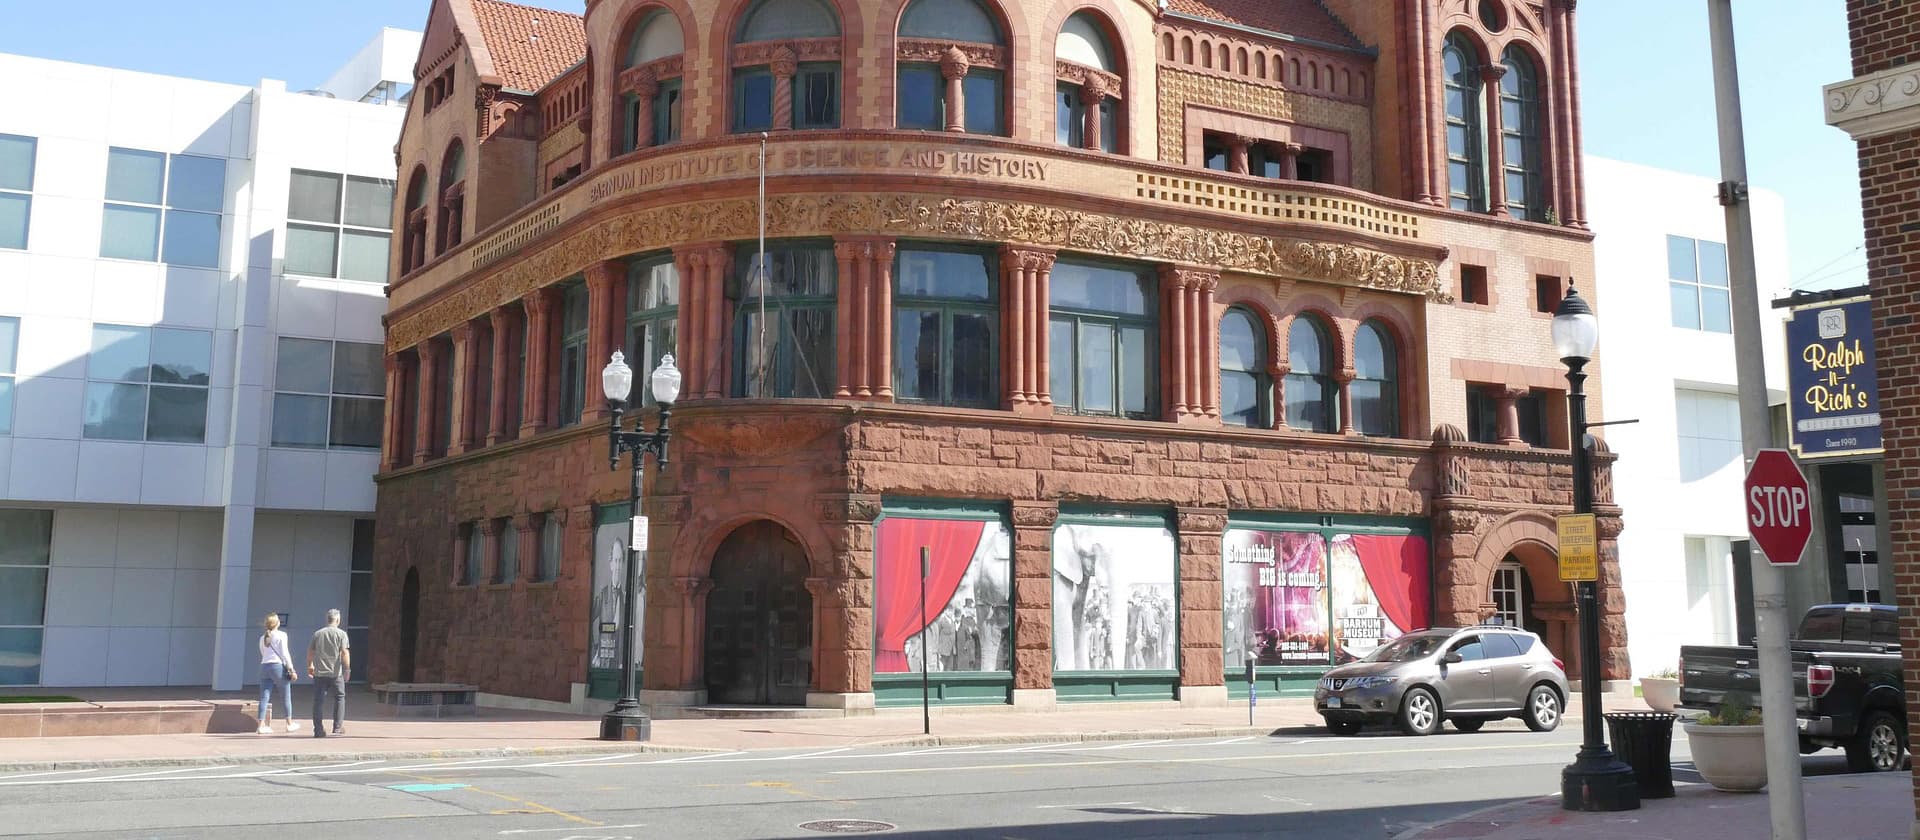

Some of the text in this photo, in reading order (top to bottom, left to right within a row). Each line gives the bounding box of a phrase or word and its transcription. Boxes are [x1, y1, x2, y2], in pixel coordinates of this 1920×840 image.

[589, 149, 1049, 202] BARNUM INSTITUTE OF SCIENCE AND HISTORY
[1803, 339, 1864, 375] Ralph
[1805, 383, 1868, 413] Rich's
[1841, 437, 1857, 447] 1990
[1750, 485, 1806, 528] STOP
[1229, 543, 1276, 567] Something
[1565, 556, 1591, 565] PARKING
[1259, 567, 1276, 587] BIG
[1278, 567, 1287, 587] is
[1343, 618, 1381, 629] BARNUM
[1343, 628, 1381, 639] MUSEUM
